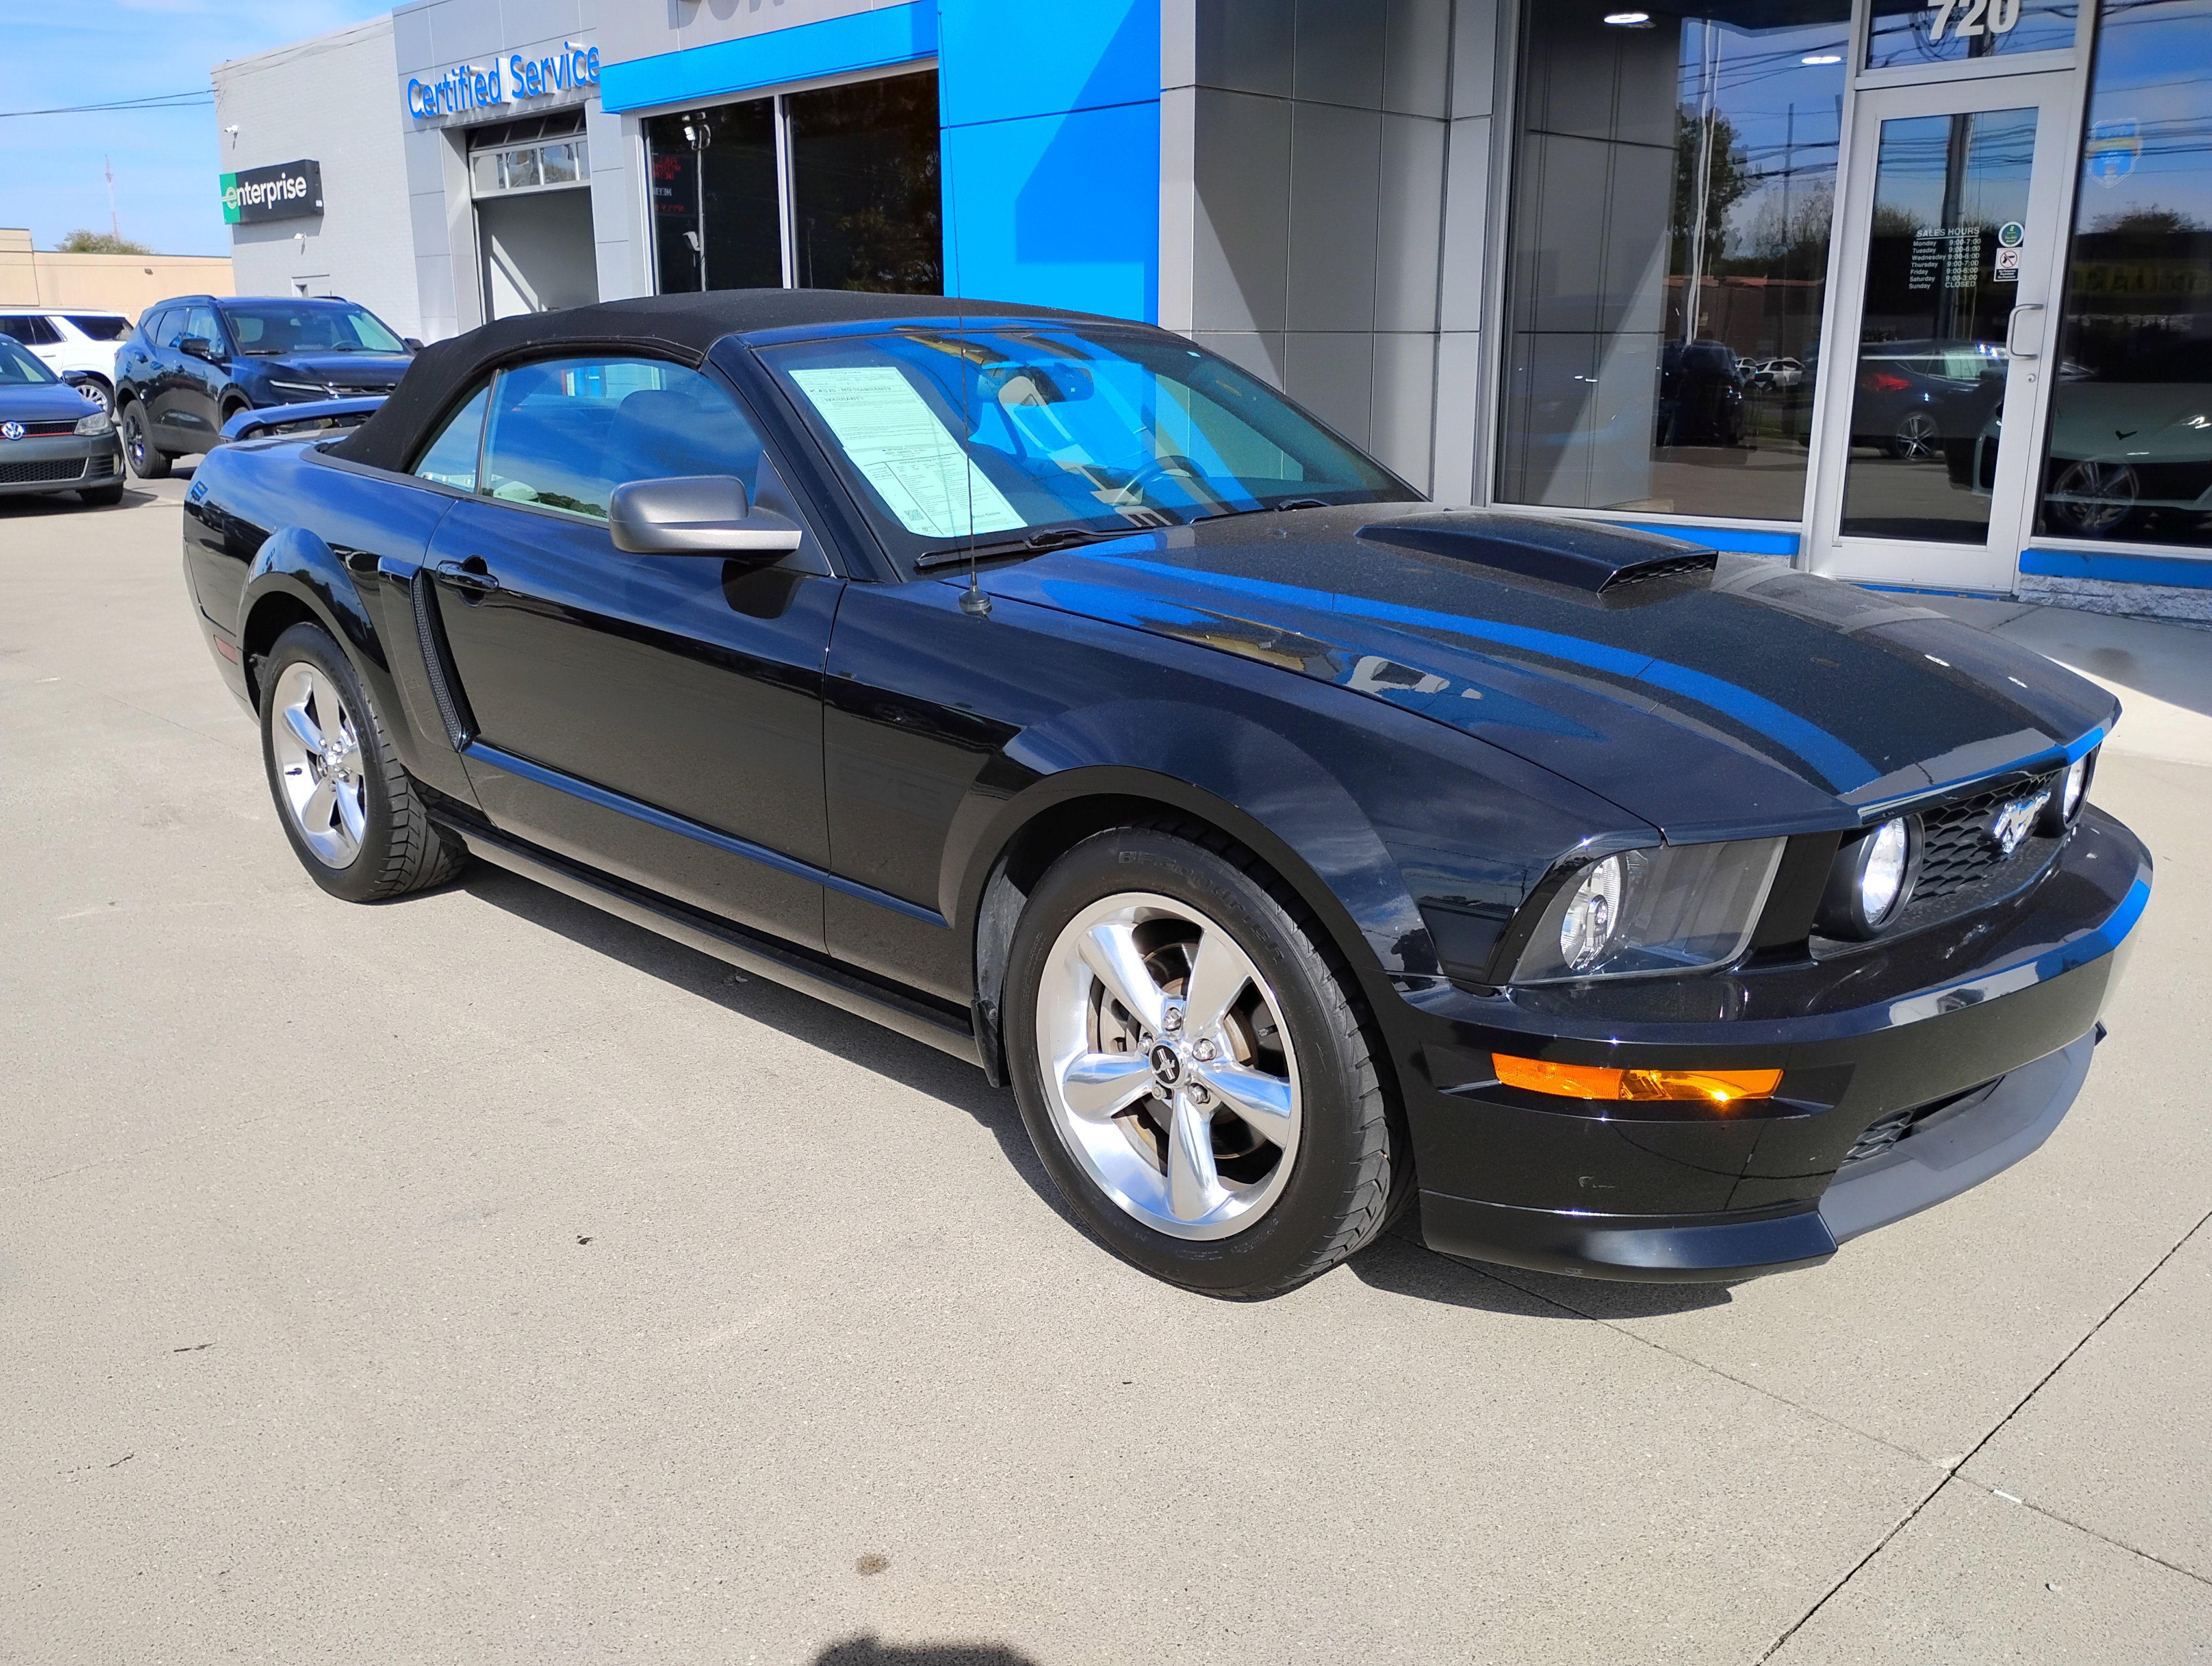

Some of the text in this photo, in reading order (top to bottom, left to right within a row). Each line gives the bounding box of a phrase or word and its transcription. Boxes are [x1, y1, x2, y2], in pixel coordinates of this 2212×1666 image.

[1928, 0, 2020, 40] 720
[408, 42, 600, 119] Certified Service
[222, 172, 307, 209] enterprise
[1917, 227, 1979, 238] SALES HOURS
